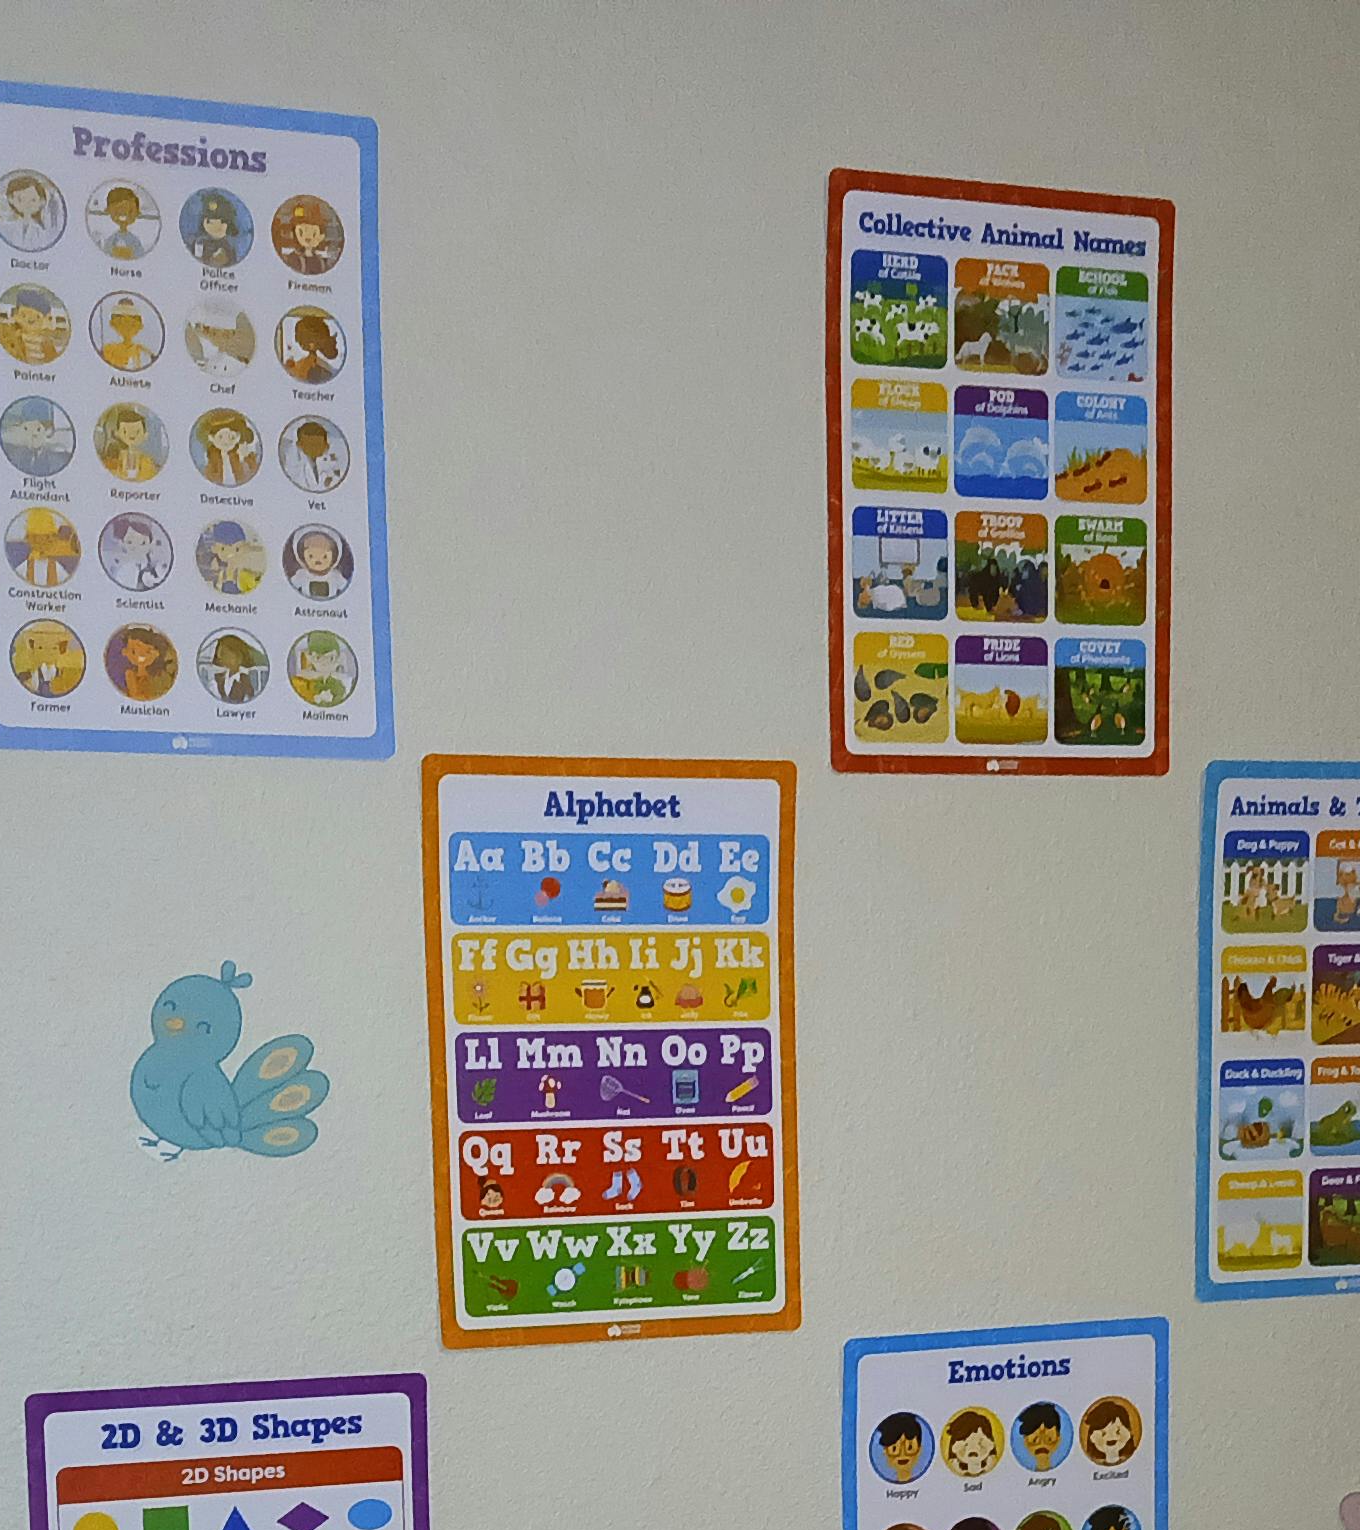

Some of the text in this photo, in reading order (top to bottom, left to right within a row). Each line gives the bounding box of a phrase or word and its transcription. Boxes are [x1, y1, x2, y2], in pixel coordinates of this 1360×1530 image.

[72, 125, 268, 174] Professions
[859, 212, 1146, 257] Collective Animal Names
[10, 259, 49, 270] Doctor
[882, 254, 918, 269] HERD
[14, 370, 56, 383] Painter
[210, 383, 236, 395] Chef
[292, 388, 335, 402] Teacher
[989, 390, 1014, 404] POD
[1076, 395, 1126, 410] COLONY
[976, 403, 1028, 415] of Dolphins
[23, 478, 56, 491] Flight
[10, 489, 70, 502] Attendant
[110, 489, 160, 503] Reporter
[200, 494, 254, 507] Detective
[307, 500, 326, 511] Vet
[876, 509, 923, 524] LITTER
[981, 514, 1023, 528] TROOP
[877, 523, 923, 535] of Kittens
[8, 587, 82, 601] Construction
[26, 600, 67, 613] Worker
[115, 598, 165, 611] Scientist
[205, 603, 258, 615] Mechanic
[294, 606, 348, 619] Astronaut
[984, 638, 1020, 651] PRIDE
[1079, 641, 1121, 654] COVEY
[984, 651, 1020, 663] of Lions
[120, 705, 169, 718] Musician
[216, 708, 256, 720] Lawyer
[302, 710, 349, 722] Mailman
[544, 790, 681, 826] Alphabet
[1230, 796, 1320, 817] Animals
[1329, 797, 1346, 817] &
[454, 840, 759, 874] Aa Bb Cc Dd Ee
[458, 936, 764, 980] Ff Gg Hh Ii Jj Kk
[1328, 953, 1352, 965] Tiger
[464, 1035, 765, 1073] Ll Mm Nn Oo Pp
[1224, 1067, 1302, 1081] Duck & Duckling
[463, 1128, 768, 1176] Qq Rr Ss Tt Uu
[467, 1222, 769, 1263] Vv Ww Xx Yy Zz
[948, 1354, 1071, 1384] Emotions
[101, 1413, 362, 1450] 2D & 3D Shapes
[182, 1464, 285, 1484] 2D Shapes
[1093, 1470, 1129, 1481] Excited
[964, 1482, 982, 1493] Sad
[1028, 1476, 1056, 1487] Angry
[886, 1489, 919, 1500] Happy
